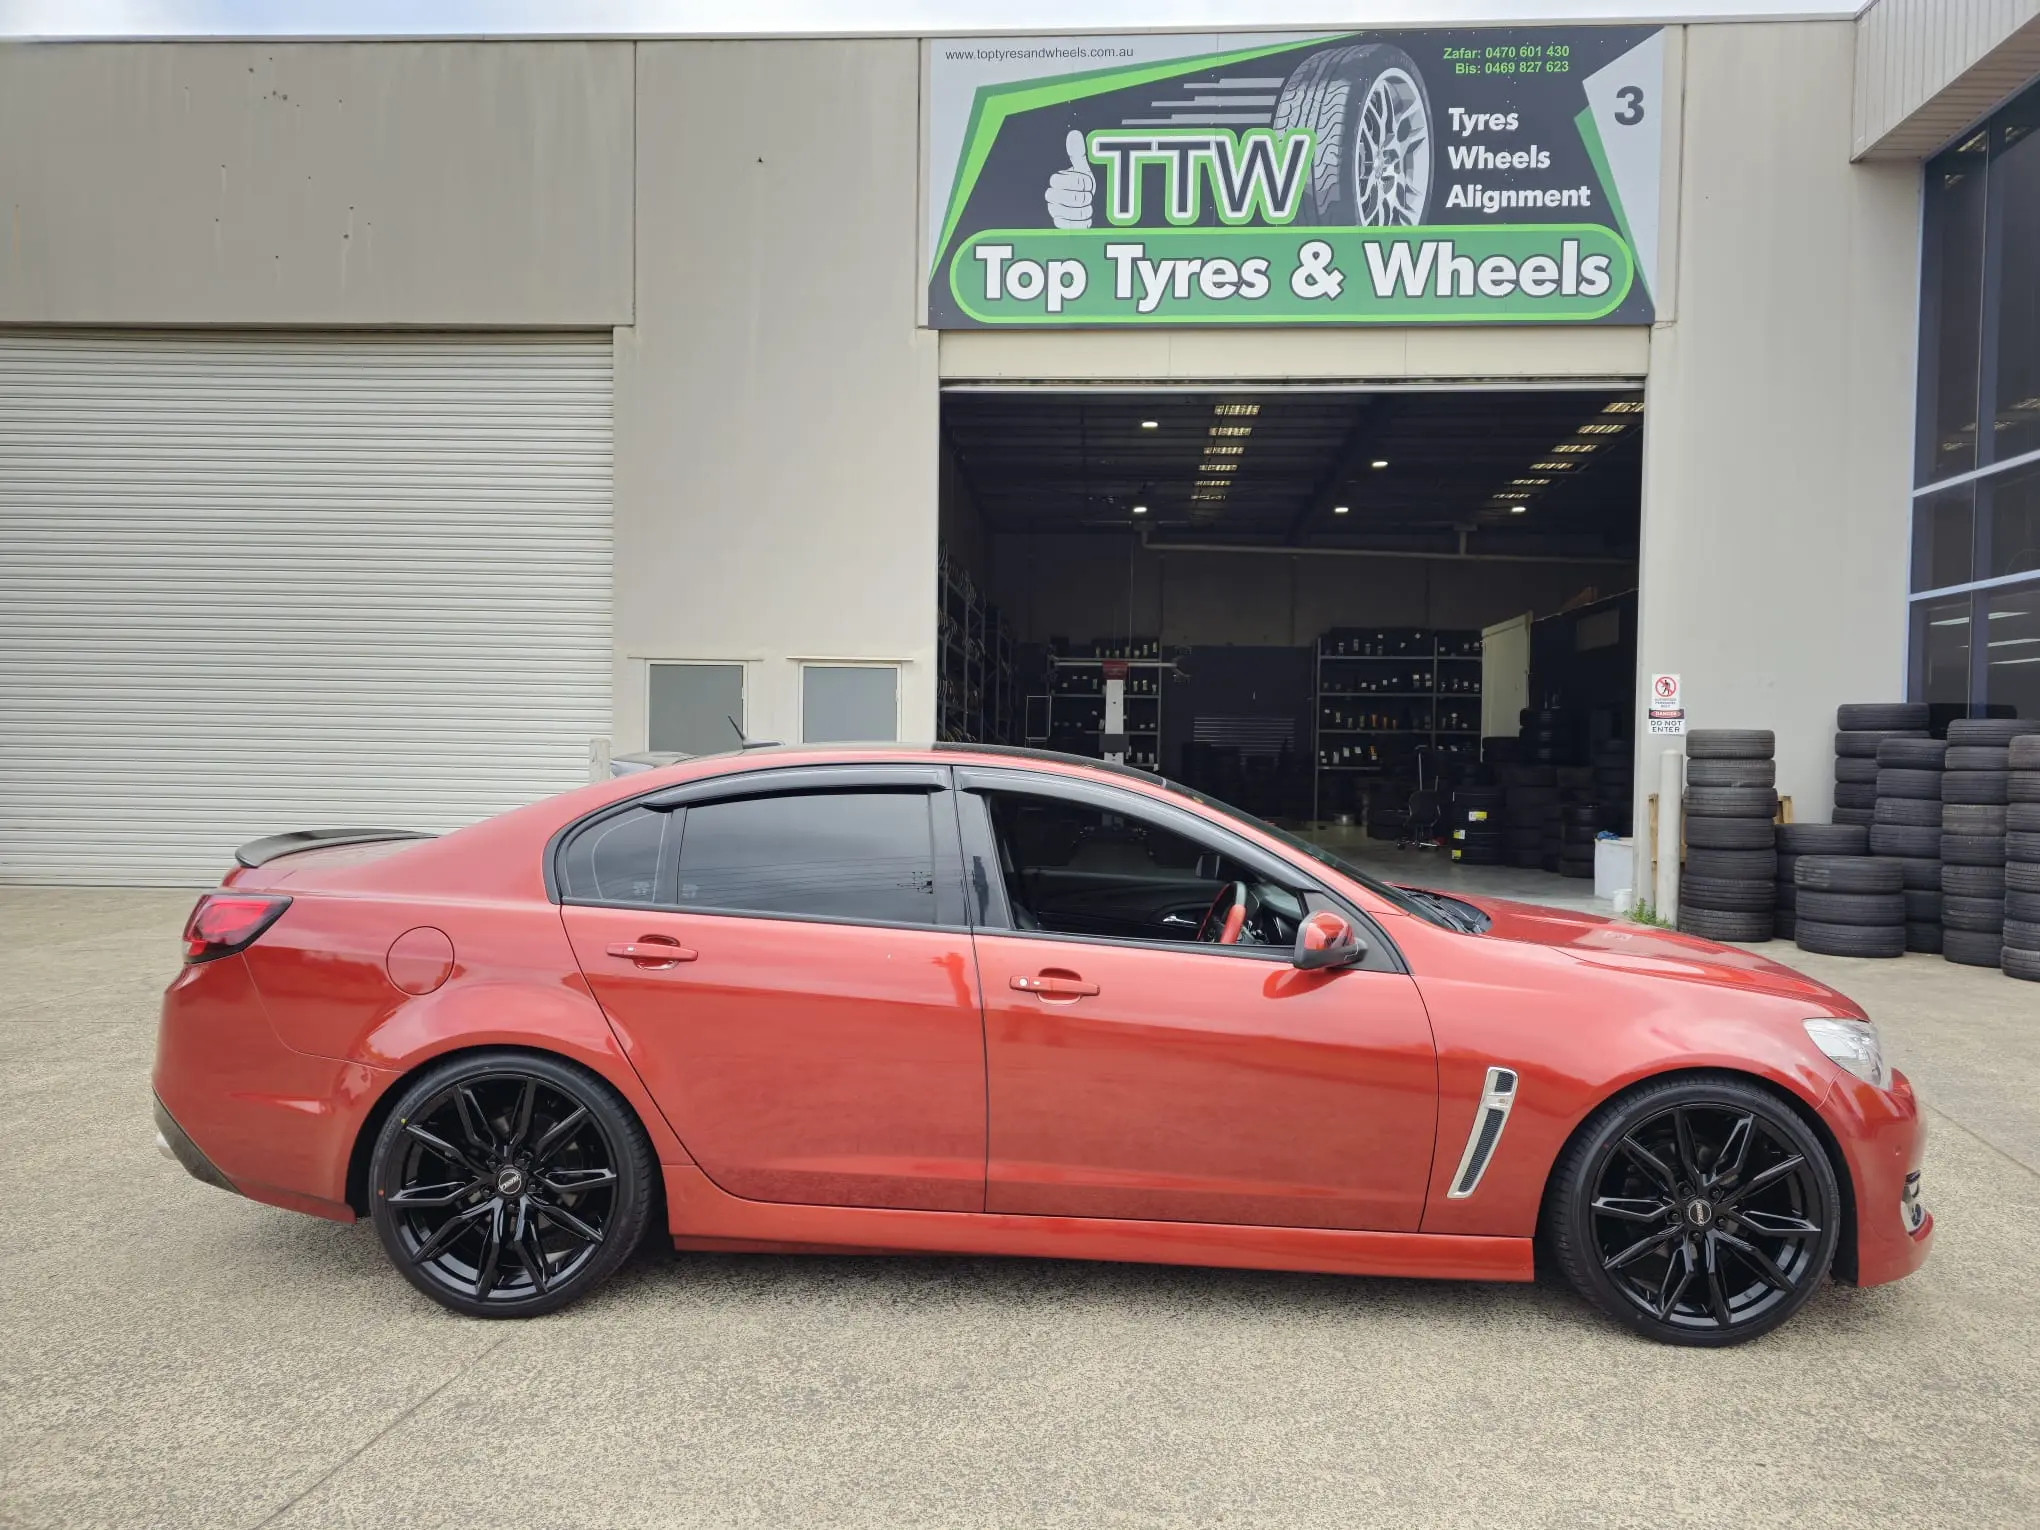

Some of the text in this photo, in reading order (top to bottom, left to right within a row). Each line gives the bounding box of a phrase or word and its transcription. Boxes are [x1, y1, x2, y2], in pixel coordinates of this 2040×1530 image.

[945, 46, 1134, 62] www.toptyresandwheels.com.au
[1443, 45, 1570, 59] Zafar: 0470 601 430
[1455, 61, 1569, 74] Bis: 0469 827 623
[1614, 85, 1645, 126] 3
[1448, 107, 1519, 137] Tyres
[1448, 145, 1551, 170] Wheels
[1090, 132, 1312, 220] TTW
[1445, 184, 1591, 213] Alignment
[974, 238, 1612, 313] Top Tyres & Wheels
